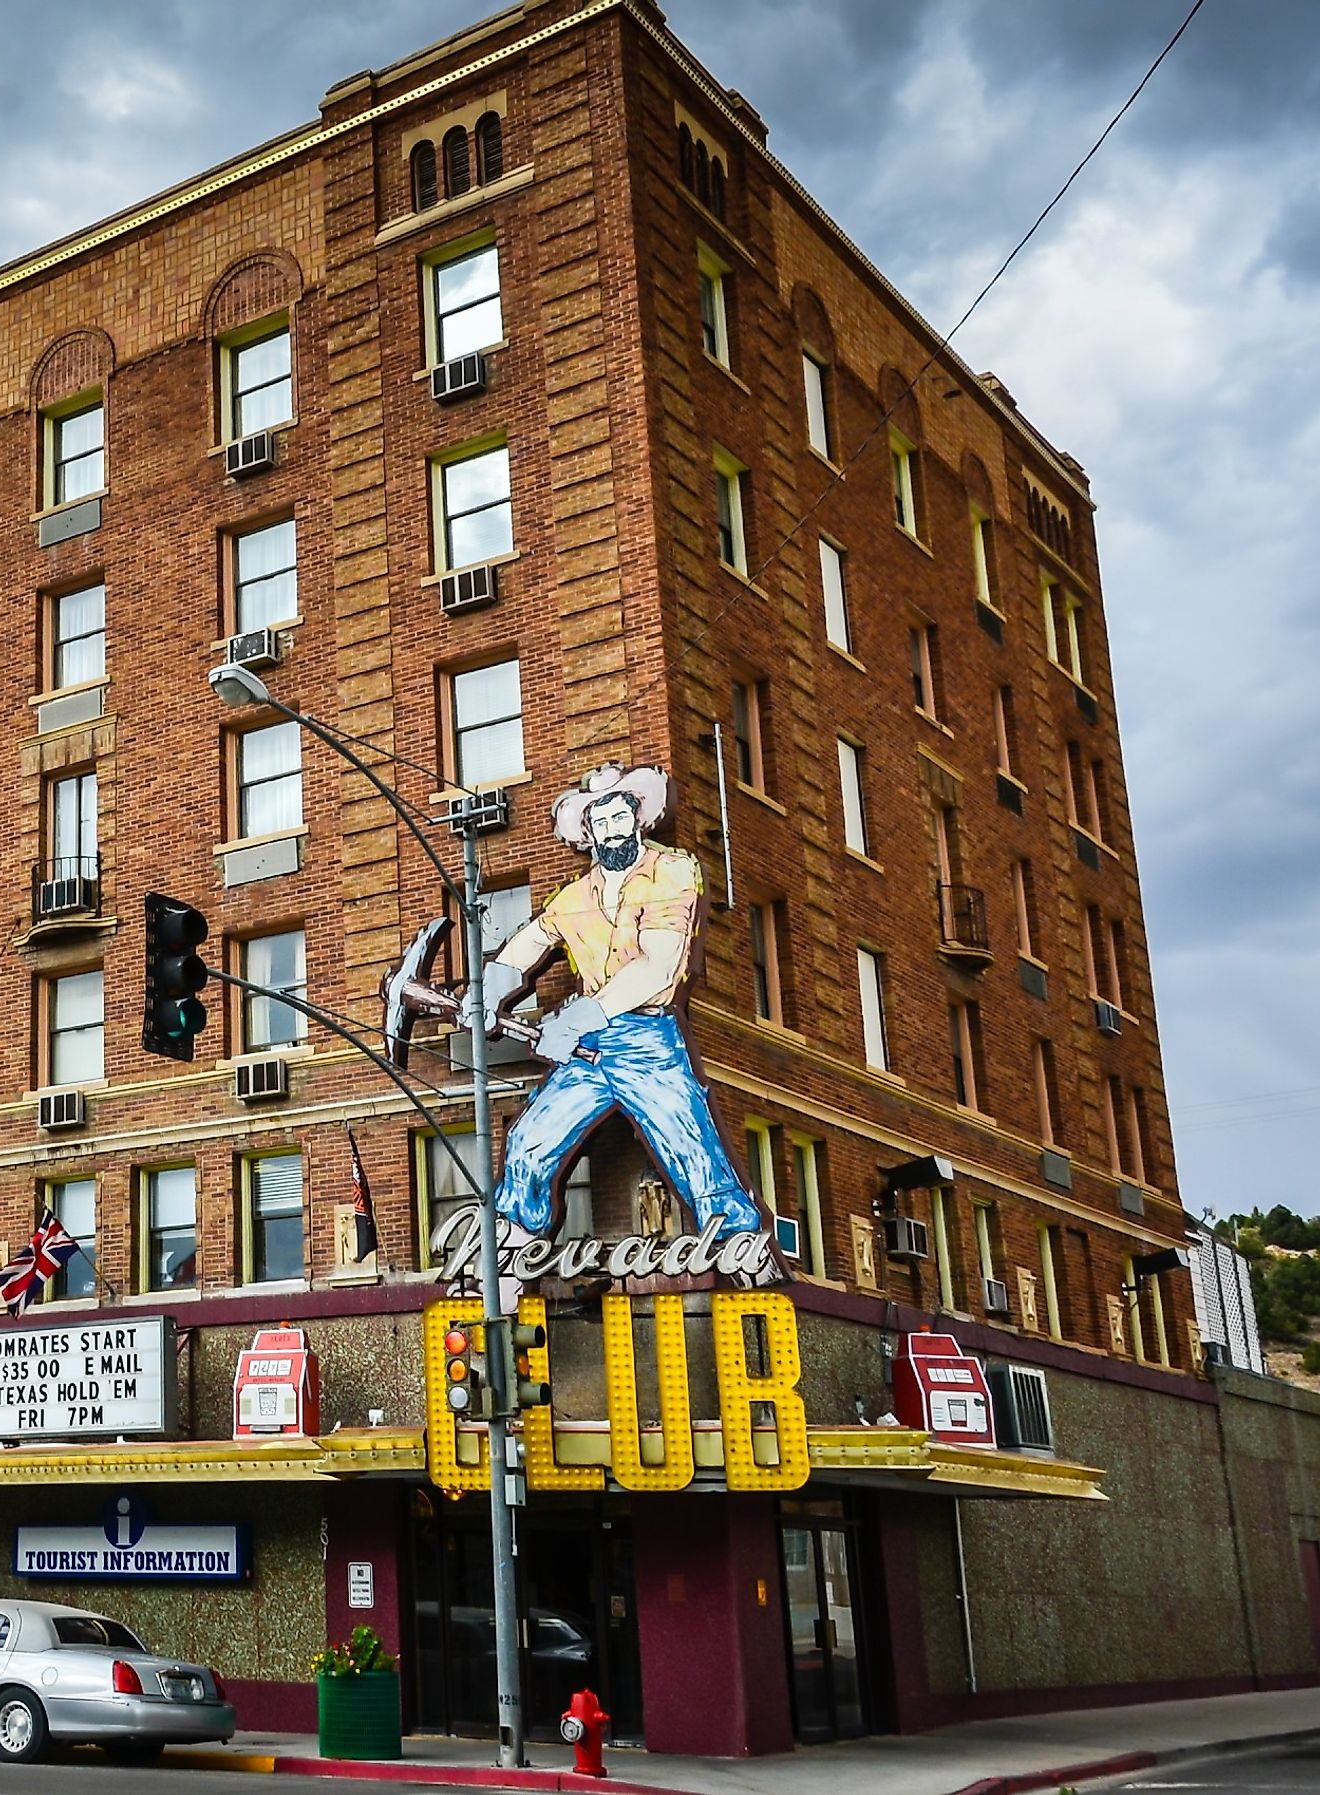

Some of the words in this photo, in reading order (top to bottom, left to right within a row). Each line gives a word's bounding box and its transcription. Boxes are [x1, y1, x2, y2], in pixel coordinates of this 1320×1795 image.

[431, 1203, 772, 1283] Nevada
[80, 1328, 137, 1352] START
[2, 1361, 29, 1382] $35
[101, 1354, 143, 1374] MAIL
[58, 1382, 100, 1402] HOLD
[423, 1291, 810, 1491] CLUB
[18, 1409, 45, 1429] FRI
[68, 1406, 104, 1427] 7PM
[26, 1551, 98, 1571] TOURIST
[102, 1551, 230, 1572] INFORMATION
